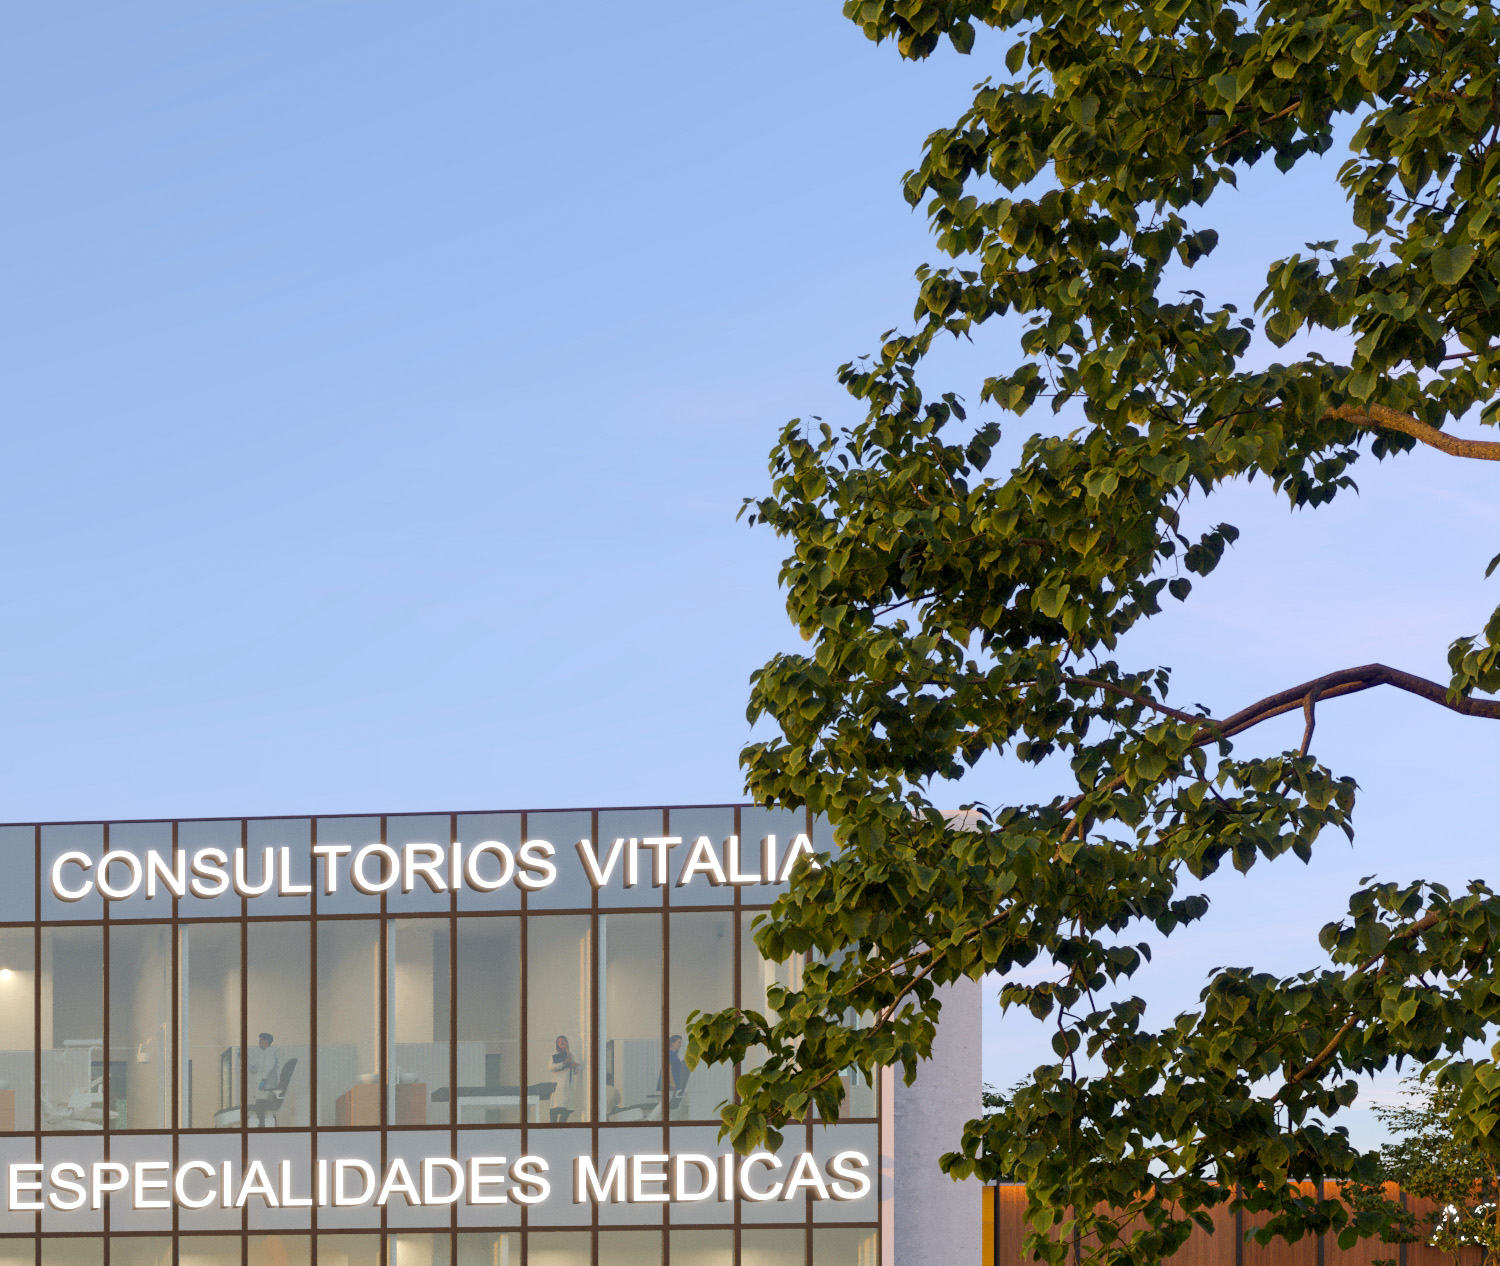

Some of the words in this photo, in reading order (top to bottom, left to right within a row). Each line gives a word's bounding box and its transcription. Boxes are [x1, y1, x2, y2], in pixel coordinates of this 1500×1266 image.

[50, 840, 557, 900] CONSULTORIOS
[7, 1157, 552, 1211] ESPECIALIDADES
[574, 1151, 873, 1203] MEDICAS
